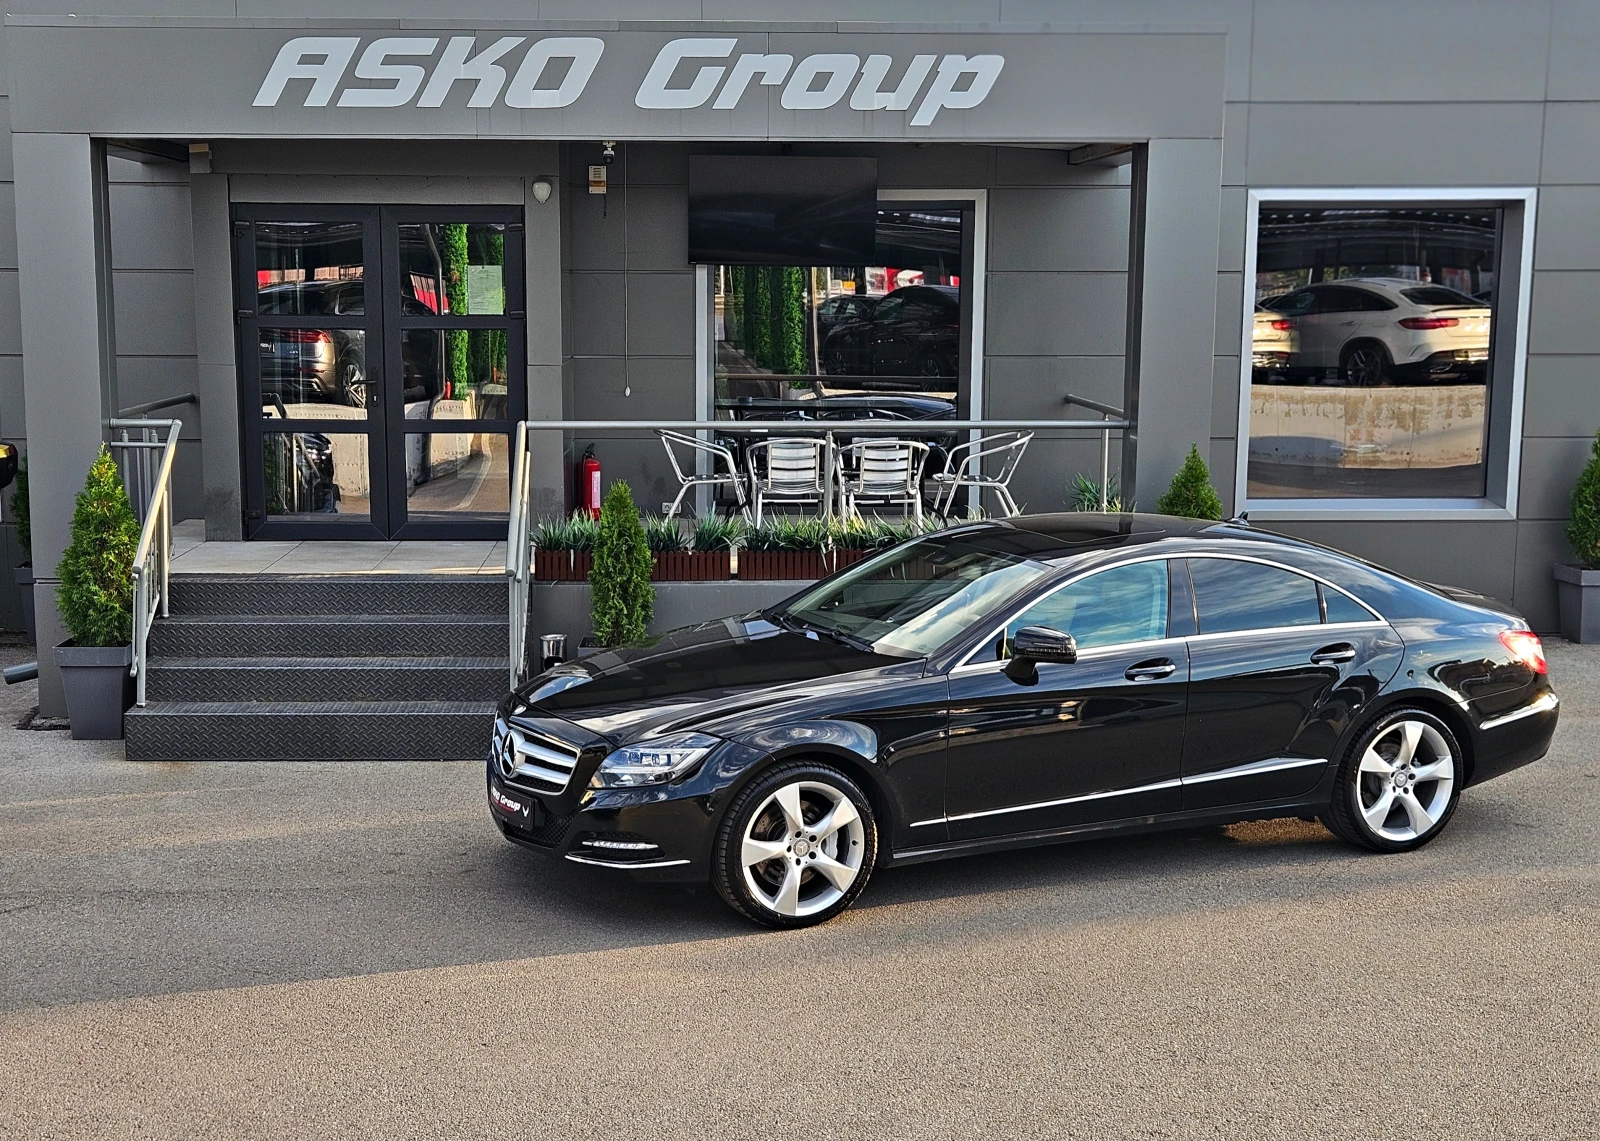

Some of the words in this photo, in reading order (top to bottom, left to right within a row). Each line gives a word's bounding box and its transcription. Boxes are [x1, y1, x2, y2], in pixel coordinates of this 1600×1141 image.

[252, 37, 605, 108] ASKO
[635, 38, 1004, 126] Group
[500, 794, 521, 811] Group
